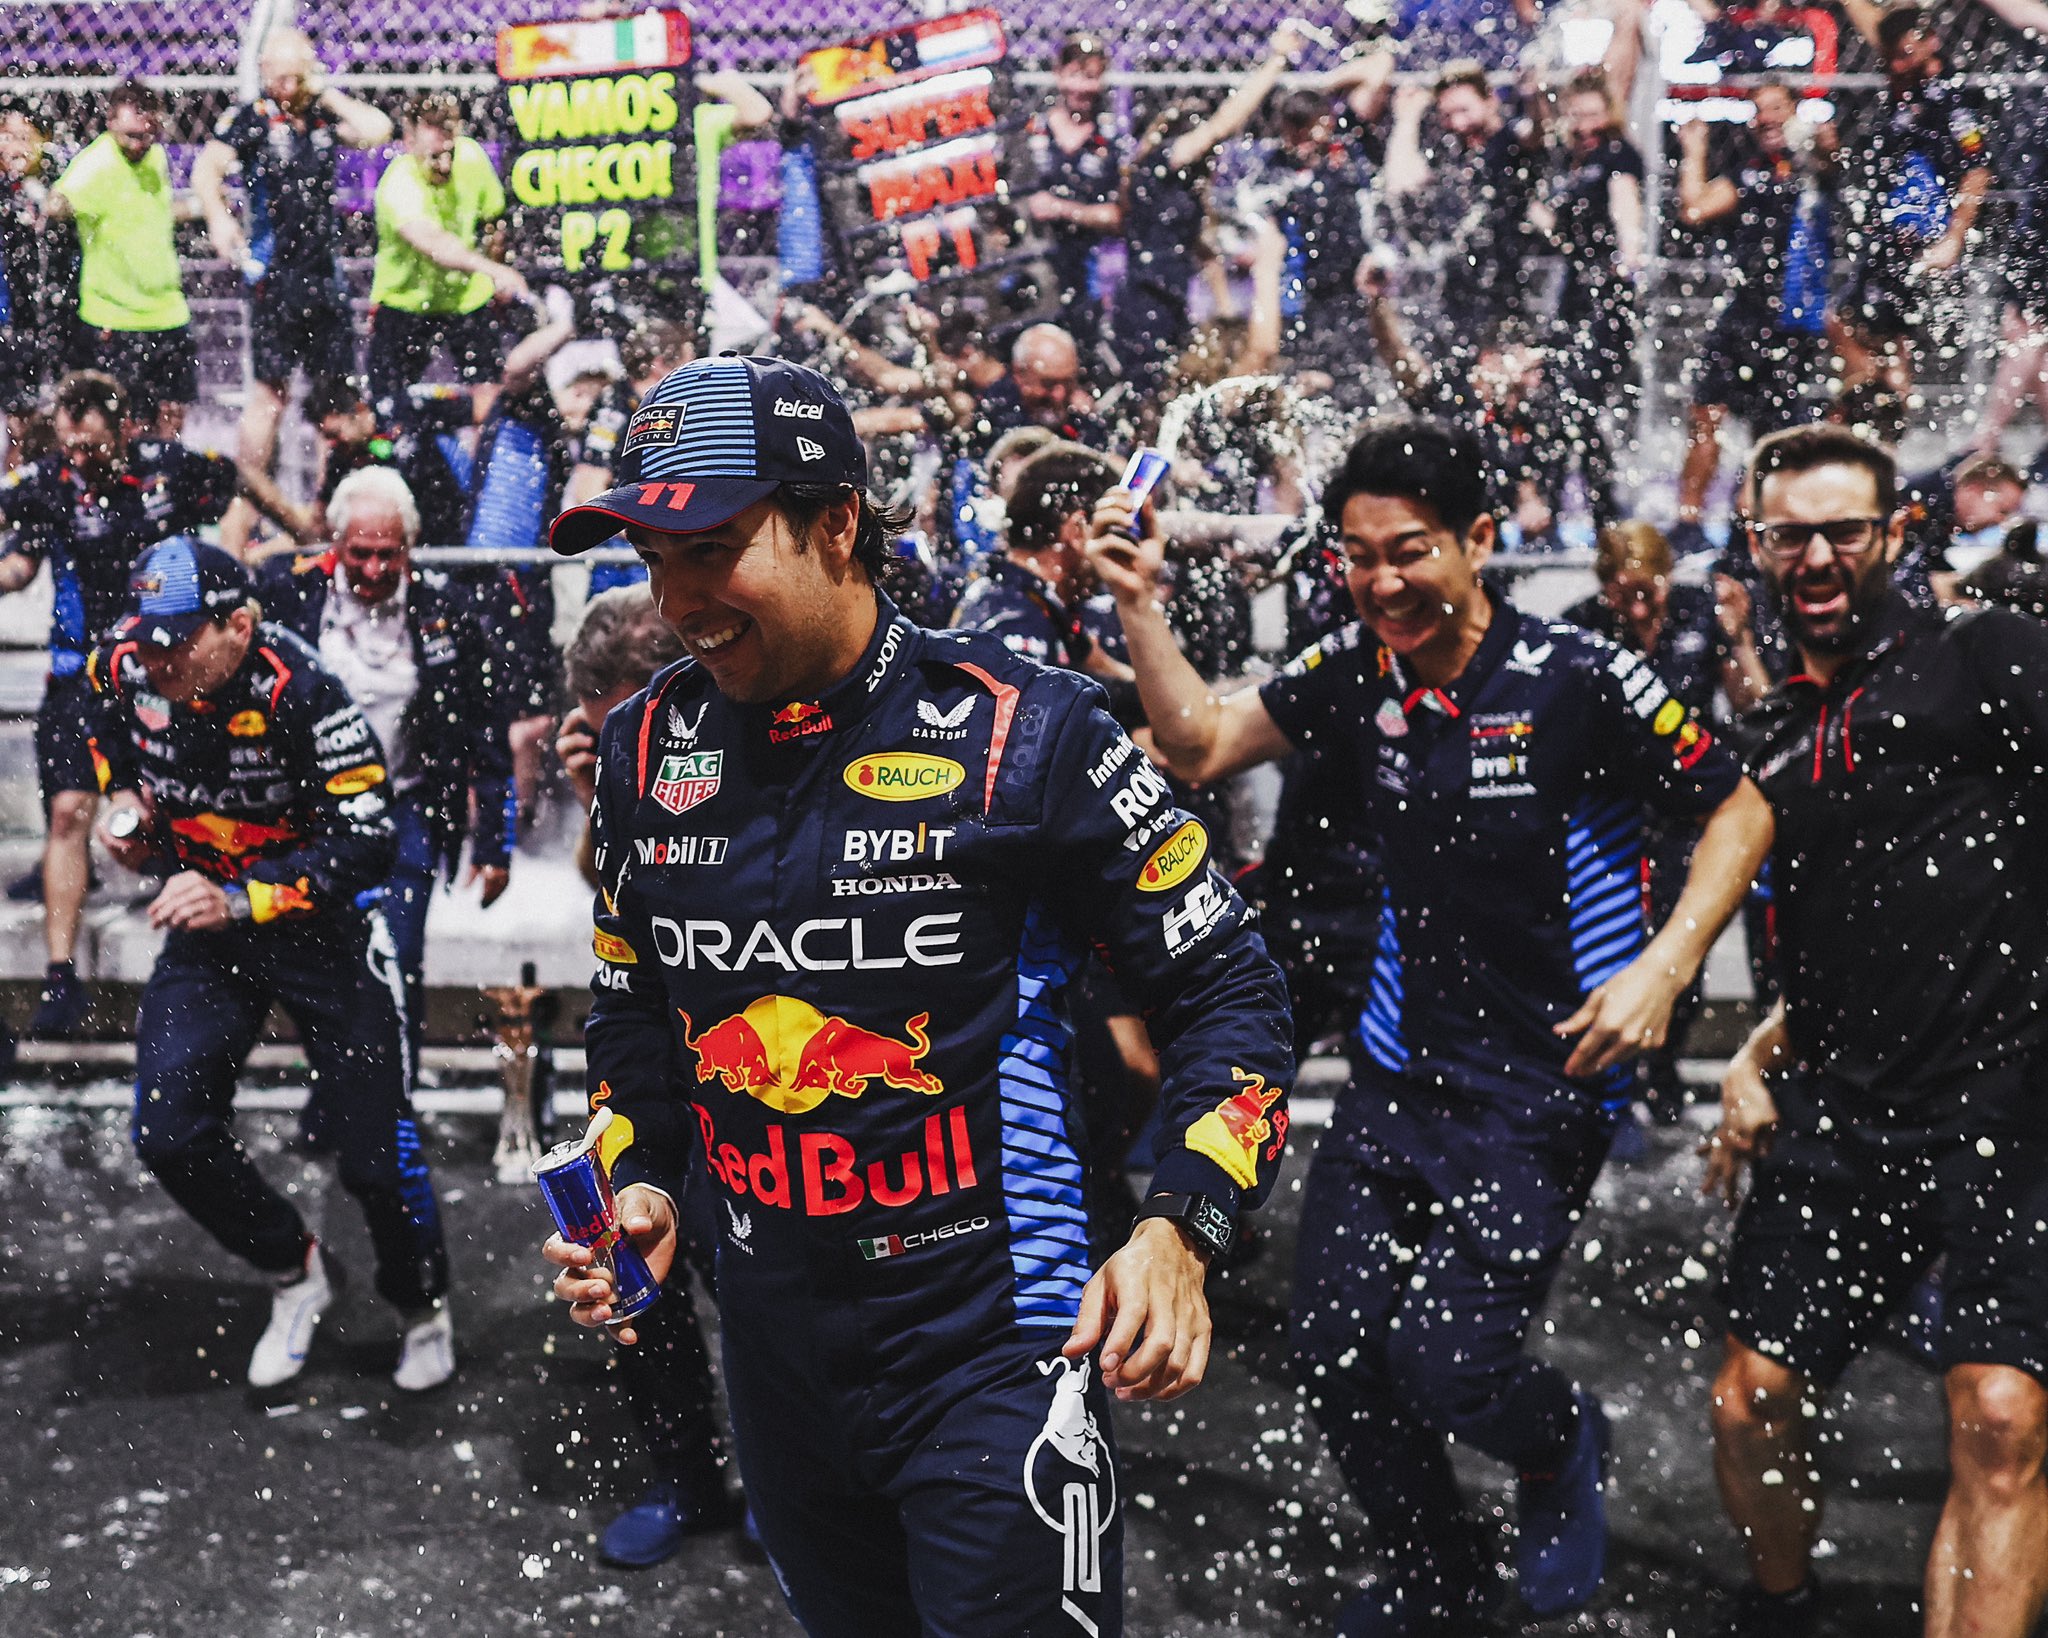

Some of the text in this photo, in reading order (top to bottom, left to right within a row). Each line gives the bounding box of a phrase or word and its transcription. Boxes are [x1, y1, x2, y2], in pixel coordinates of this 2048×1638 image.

[508, 72, 679, 142] VAMOS
[511, 140, 674, 208] CHECO!
[561, 208, 632, 273] P2
[633, 410, 677, 427] ORACLE
[773, 397, 824, 420] telcel
[638, 482, 696, 511] 11
[659, 736, 699, 749] CASTOE
[769, 715, 833, 744] Red Bull
[912, 727, 968, 741] CASTORE
[666, 755, 718, 780] TAG
[1086, 732, 1135, 789] infini
[877, 767, 950, 786] RAUCH
[657, 781, 718, 811] HEUER
[1110, 754, 1168, 830] ROK
[634, 836, 698, 865] Mobil
[843, 822, 955, 862] BYBIT
[1157, 829, 1199, 876] RAUCH
[832, 873, 961, 896] HONDA
[652, 912, 964, 971] ORACLE
[691, 1101, 978, 1217] Red Bull
[567, 1214, 602, 1242] Red
[903, 1216, 990, 1249] CHECO
